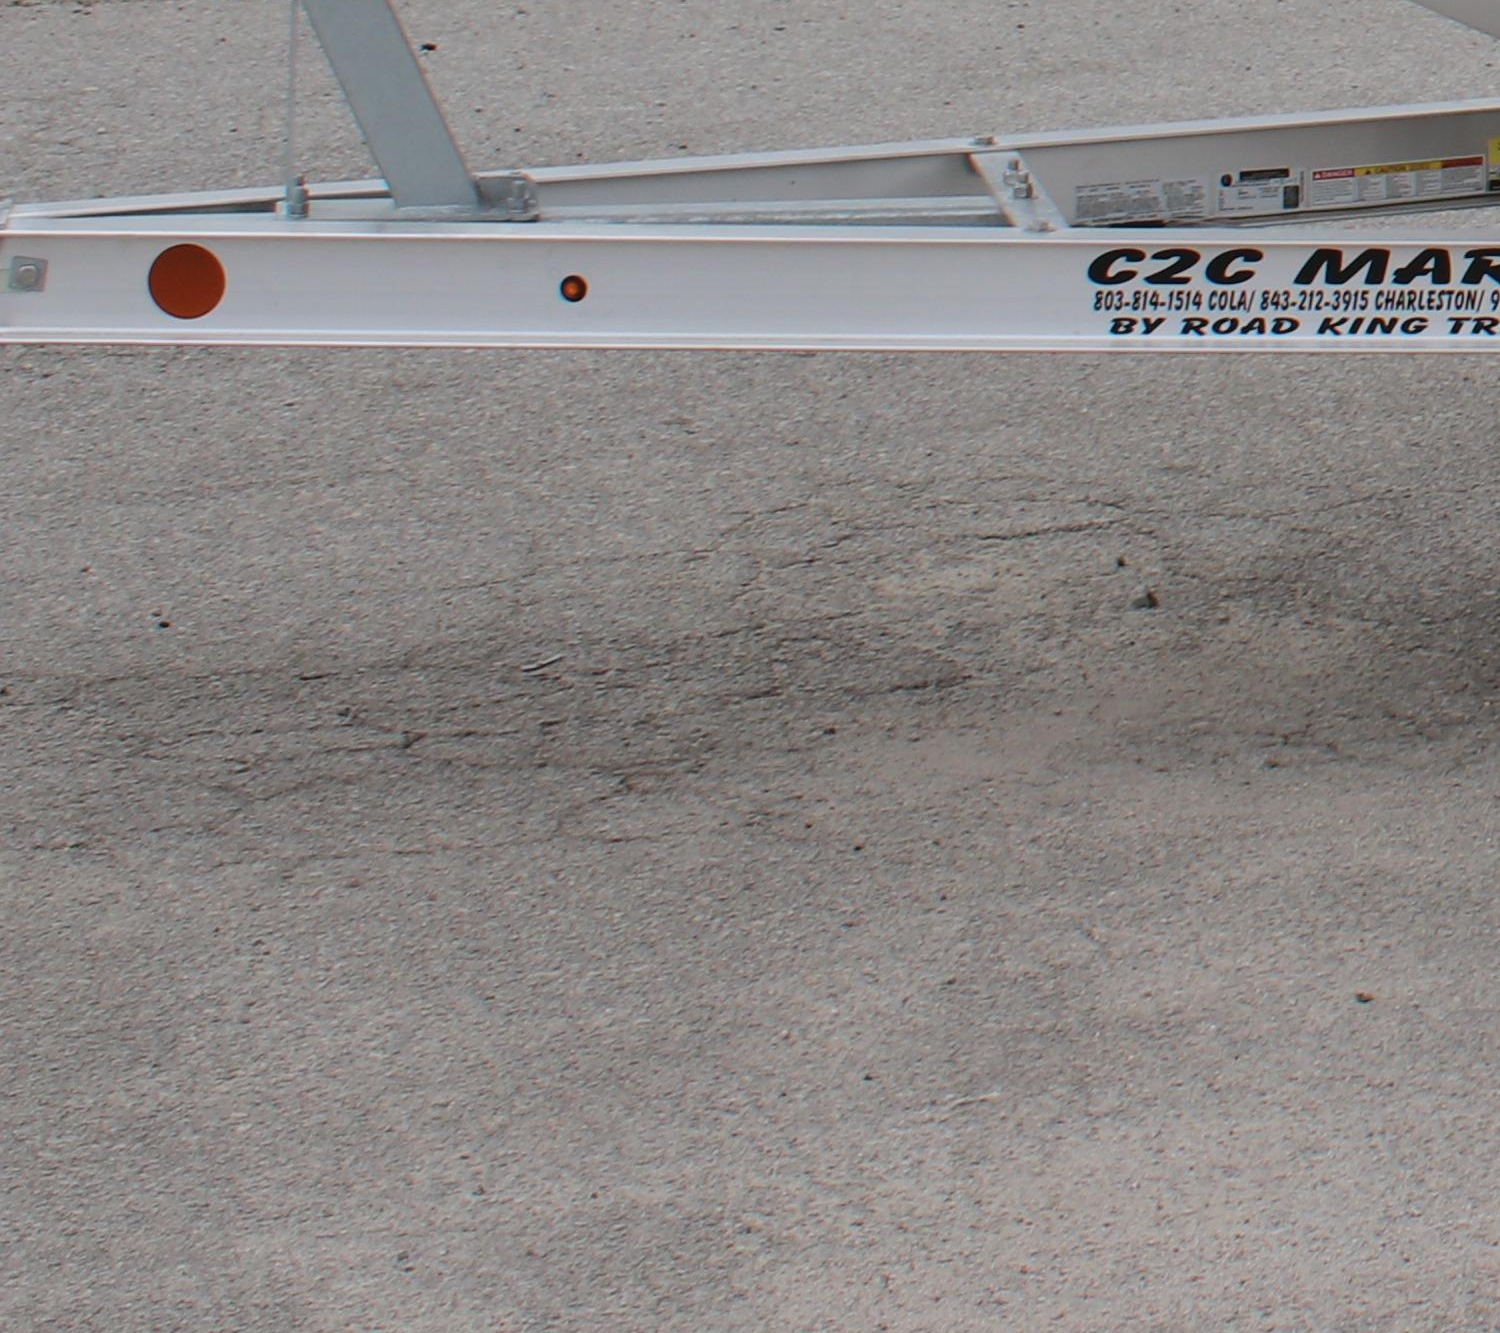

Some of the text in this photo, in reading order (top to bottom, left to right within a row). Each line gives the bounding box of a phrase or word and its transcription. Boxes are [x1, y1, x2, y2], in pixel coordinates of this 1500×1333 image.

[1088, 248, 1264, 285] C2C
[1094, 289, 1202, 311] 803-814-1514
[1208, 289, 1256, 311] COLA/
[1260, 289, 1369, 311] 843-212-3915
[1375, 289, 1485, 311] CHARLESTON/
[1110, 316, 1167, 335] BY
[1181, 316, 1300, 335] ROAD
[1316, 316, 1429, 335] KING
